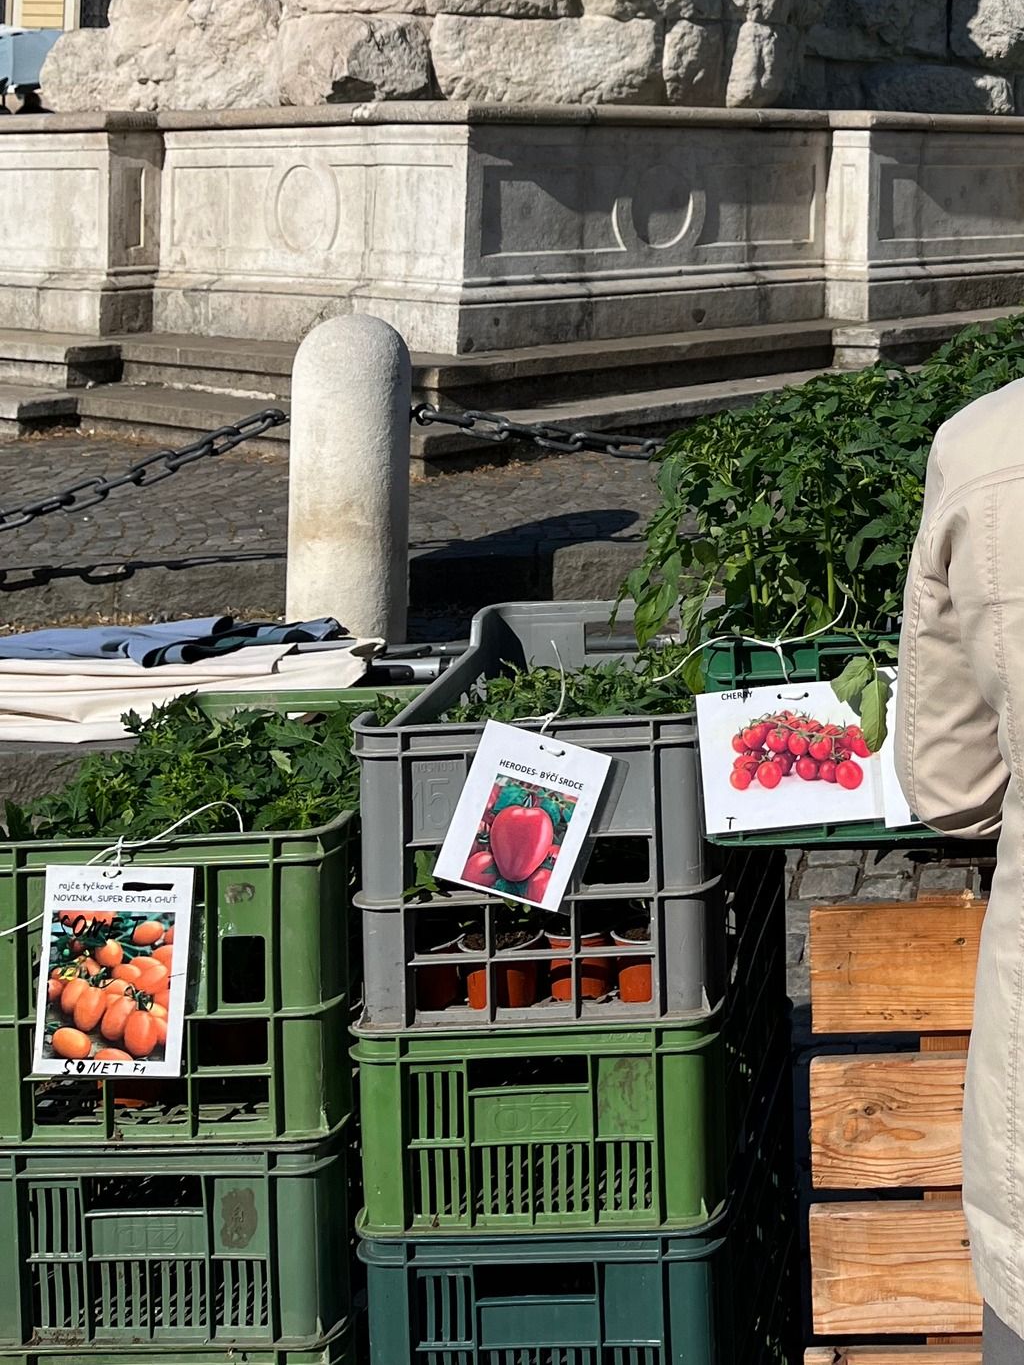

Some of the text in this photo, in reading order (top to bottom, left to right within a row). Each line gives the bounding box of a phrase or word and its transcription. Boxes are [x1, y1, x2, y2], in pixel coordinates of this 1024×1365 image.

[721, 690, 752, 700] CHERRY
[539, 772, 560, 783] BÝČÍ
[559, 779, 585, 792] SRDCE
[59, 882, 80, 892] rajče
[83, 881, 113, 892] tyčkové
[53, 894, 95, 903] NOVINKA,
[97, 895, 123, 903] SUPER
[125, 895, 152, 903] EXTRA
[60, 914, 147, 942] SONET
[62, 1059, 123, 1074] SONET
